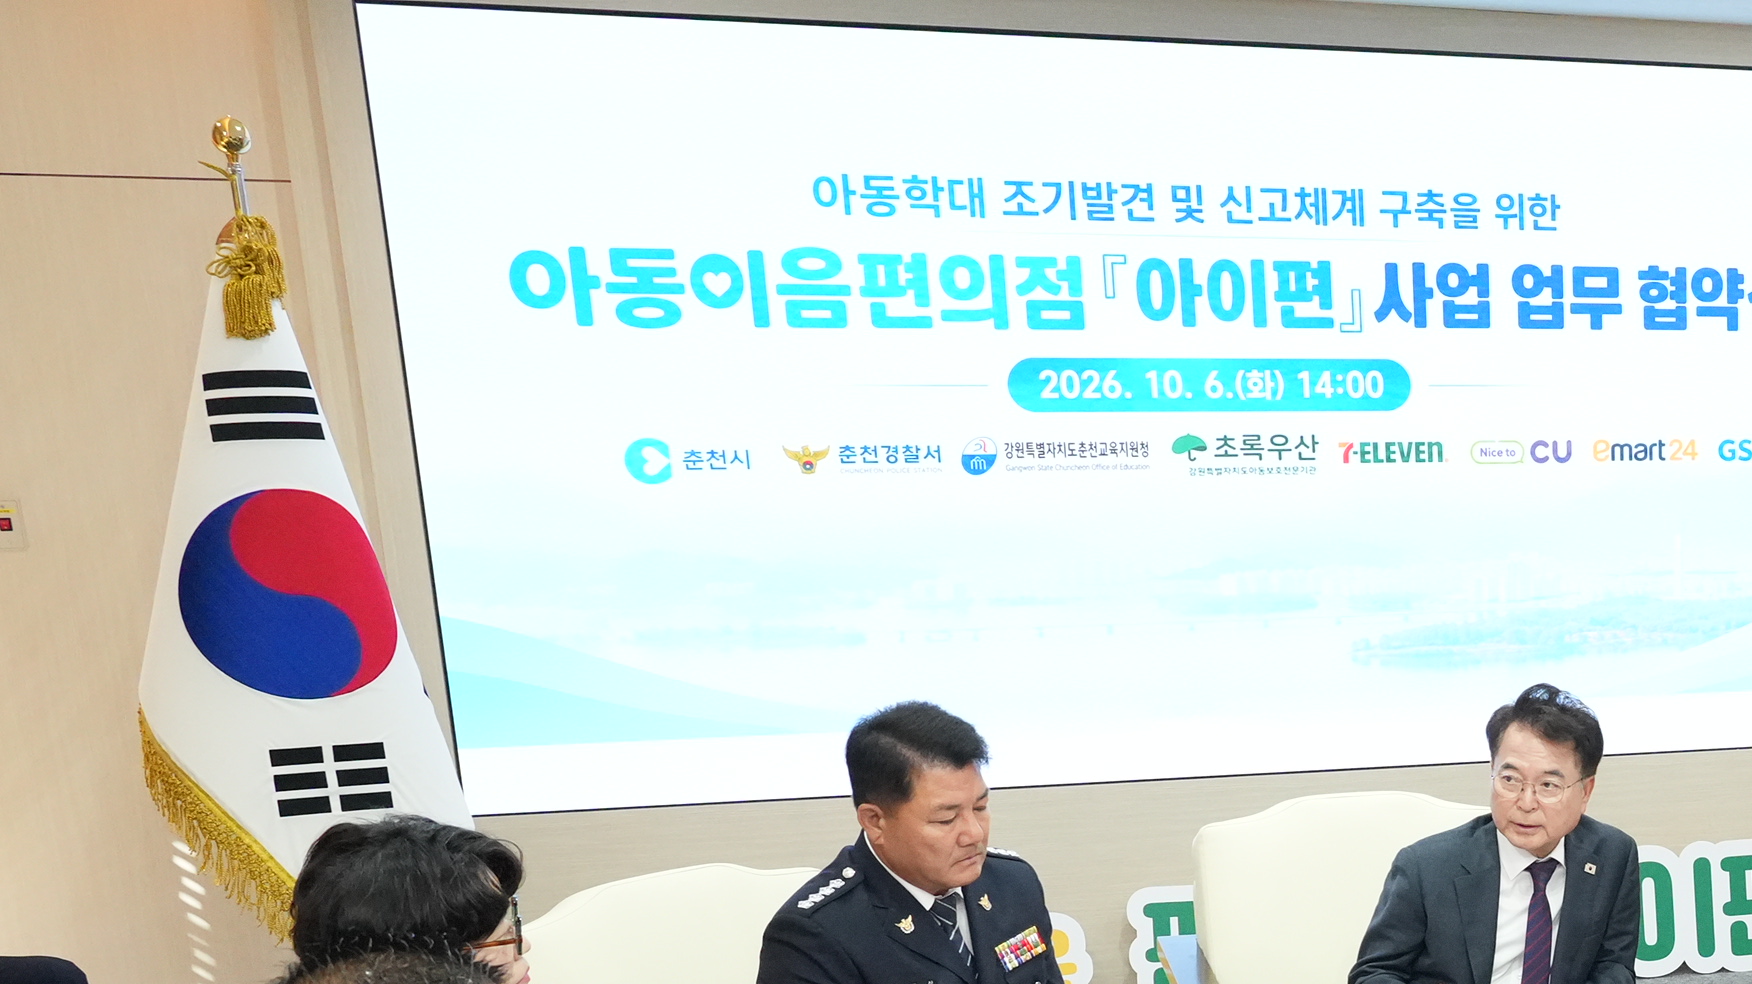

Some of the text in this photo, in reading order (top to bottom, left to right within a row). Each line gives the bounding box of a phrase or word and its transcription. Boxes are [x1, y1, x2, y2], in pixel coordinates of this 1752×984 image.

[813, 174, 1562, 232] 아동학대 조기발견 및 신고체계 구축을 위한
[508, 246, 1087, 331] 아동이음편의점
[1374, 262, 1492, 330] 사업
[1511, 264, 1624, 331] 업무
[1038, 369, 1385, 402] 2026. 10. 6.(화) 14:00
[682, 448, 752, 471] 춘천시
[838, 444, 943, 464] 춘천경찰서
[1004, 441, 1149, 460] 강원특별자치도춘천교육지원청
[1214, 434, 1320, 462] 초록우산
[1480, 447, 1516, 457] Nice to
[1530, 440, 1573, 464] CU
[1593, 438, 1699, 463] emart24
